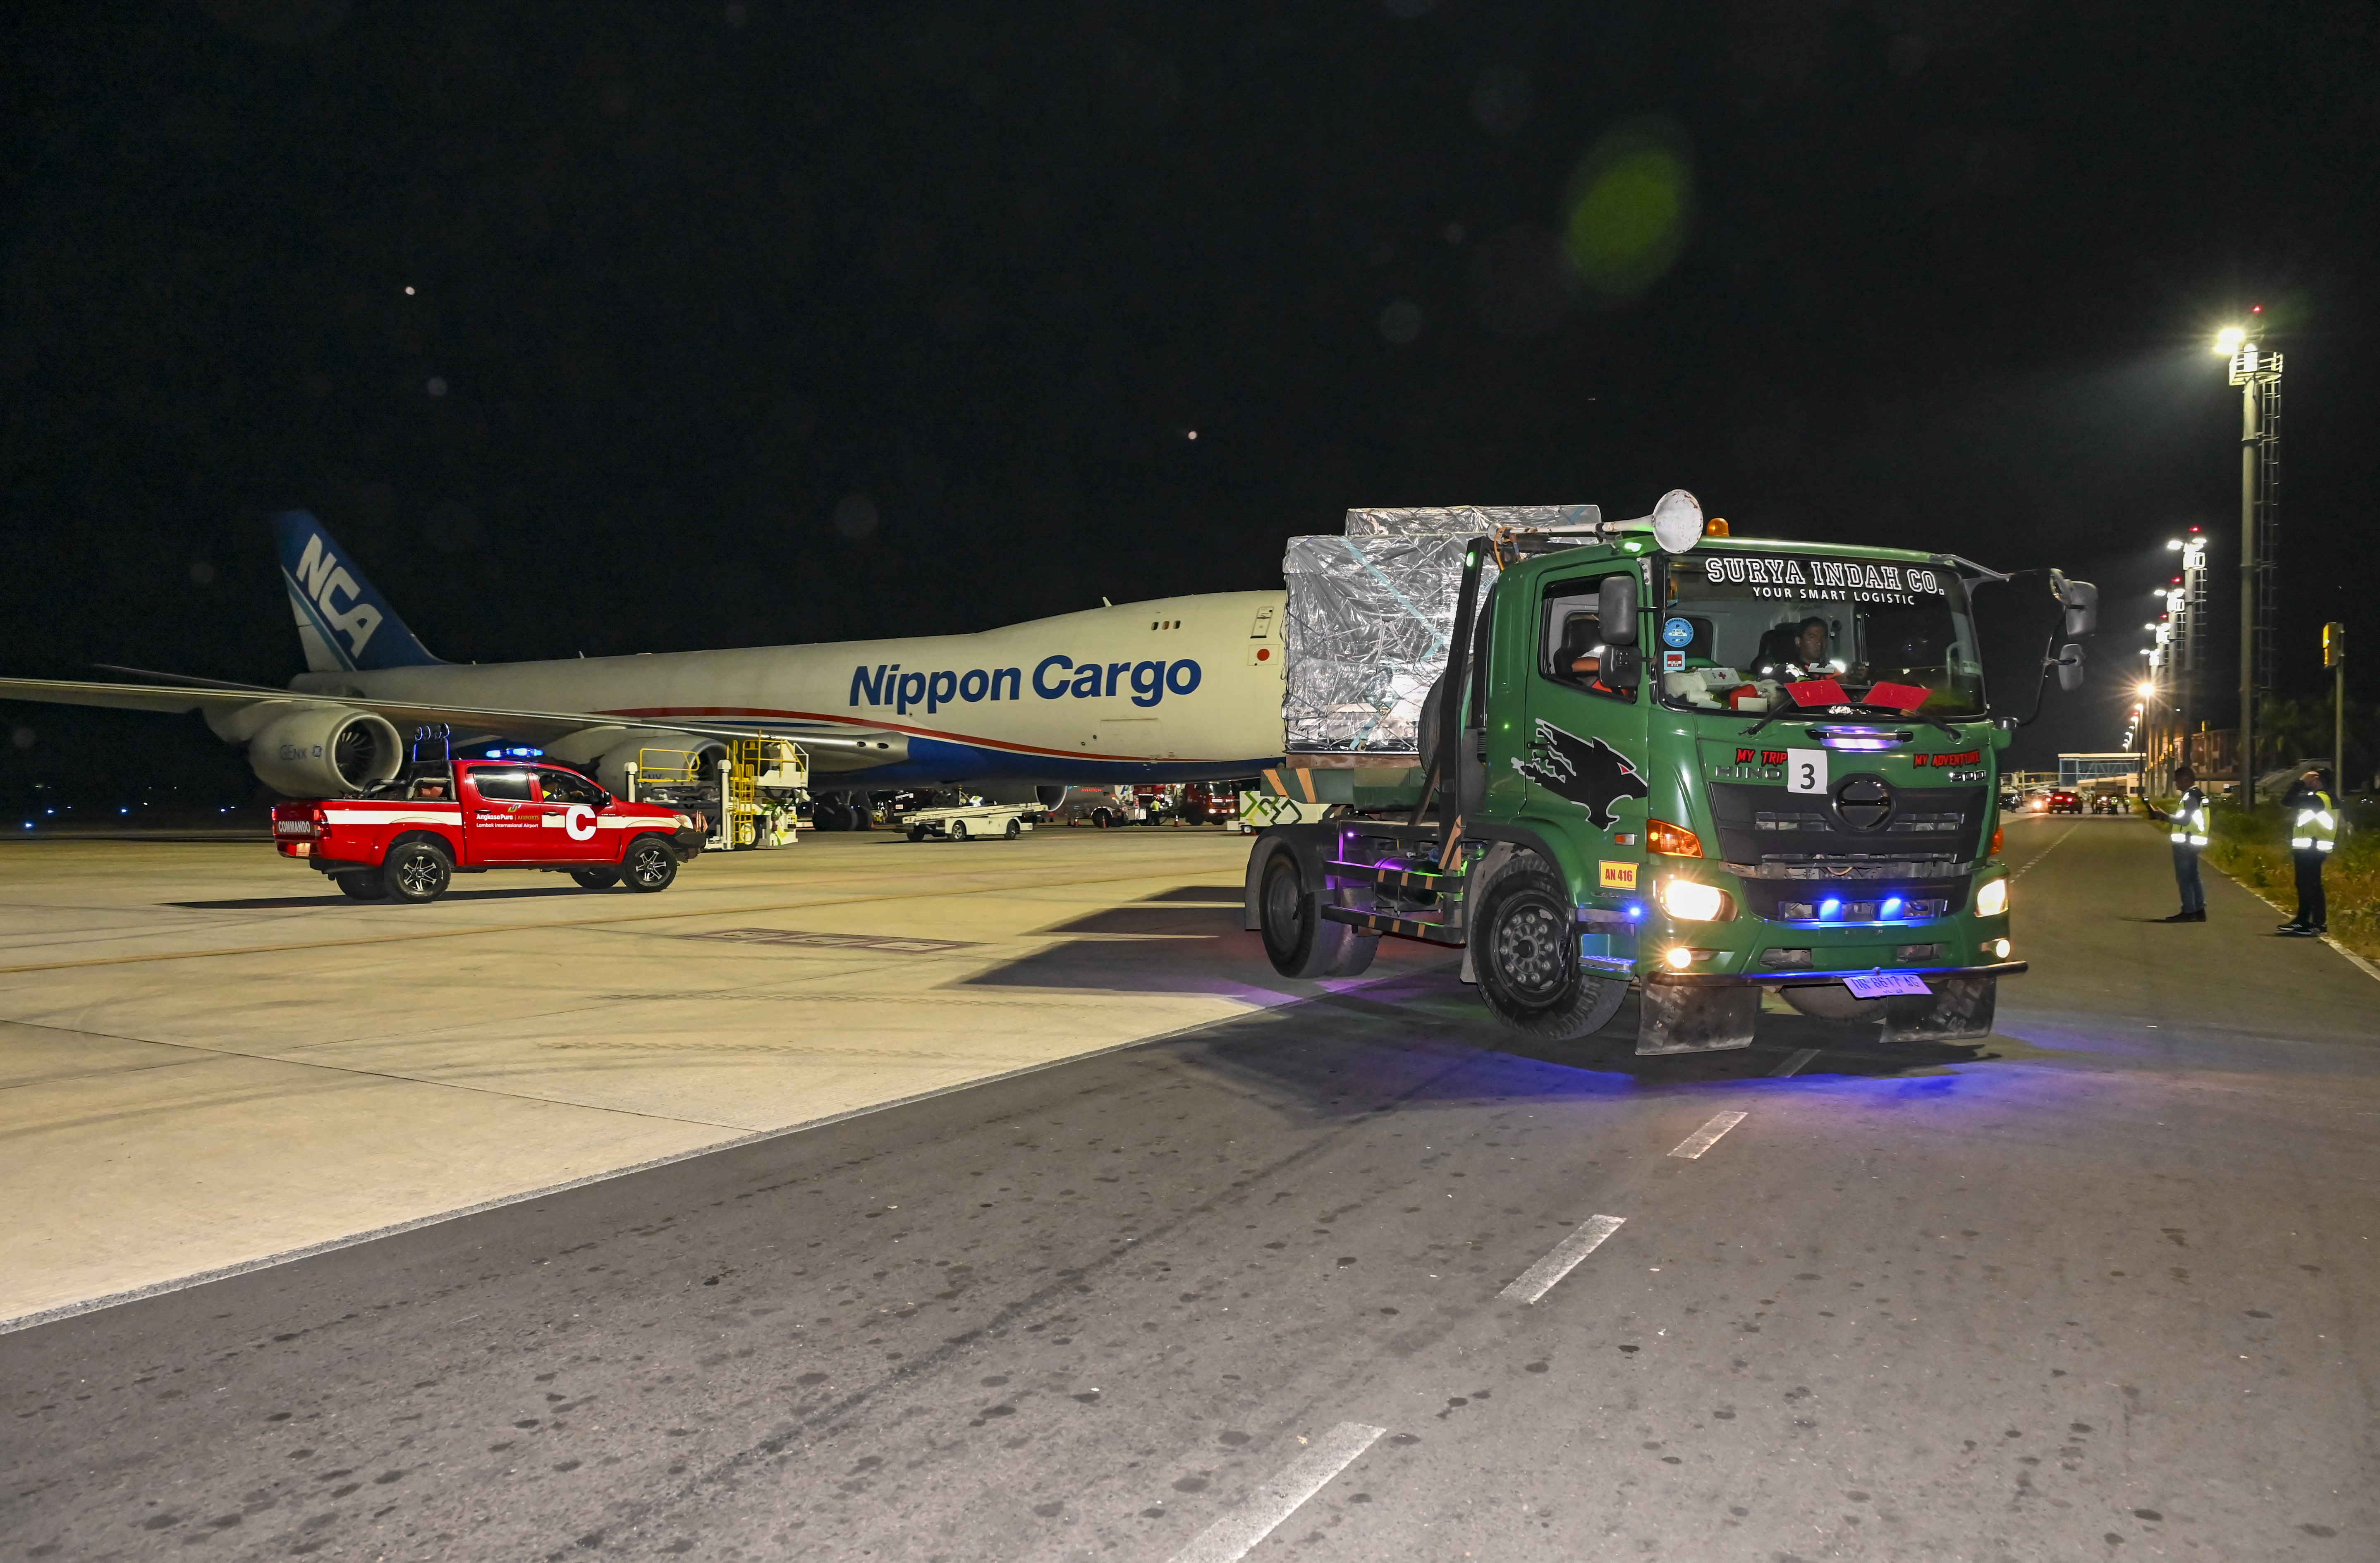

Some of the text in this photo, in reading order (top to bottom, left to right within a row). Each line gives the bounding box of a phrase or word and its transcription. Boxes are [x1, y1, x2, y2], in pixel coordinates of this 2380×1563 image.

[1705, 558, 1945, 595] SURYA INDAH CO.
[296, 533, 383, 659] NCA
[1753, 587, 1916, 605] YOUR SMART LOGISTIC
[849, 655, 1201, 715] Nippon Cargo
[1736, 748, 1787, 766] MY TRIP
[1914, 750, 1981, 768] MY ADVENTURE
[1716, 766, 1782, 780] HINO
[1800, 763, 1815, 789] 3
[278, 821, 310, 833] COMMANDO
[566, 805, 597, 841] C
[1605, 868, 1633, 882] AN 416
[1851, 979, 1871, 989] DR
[1903, 976, 1920, 987] AG
